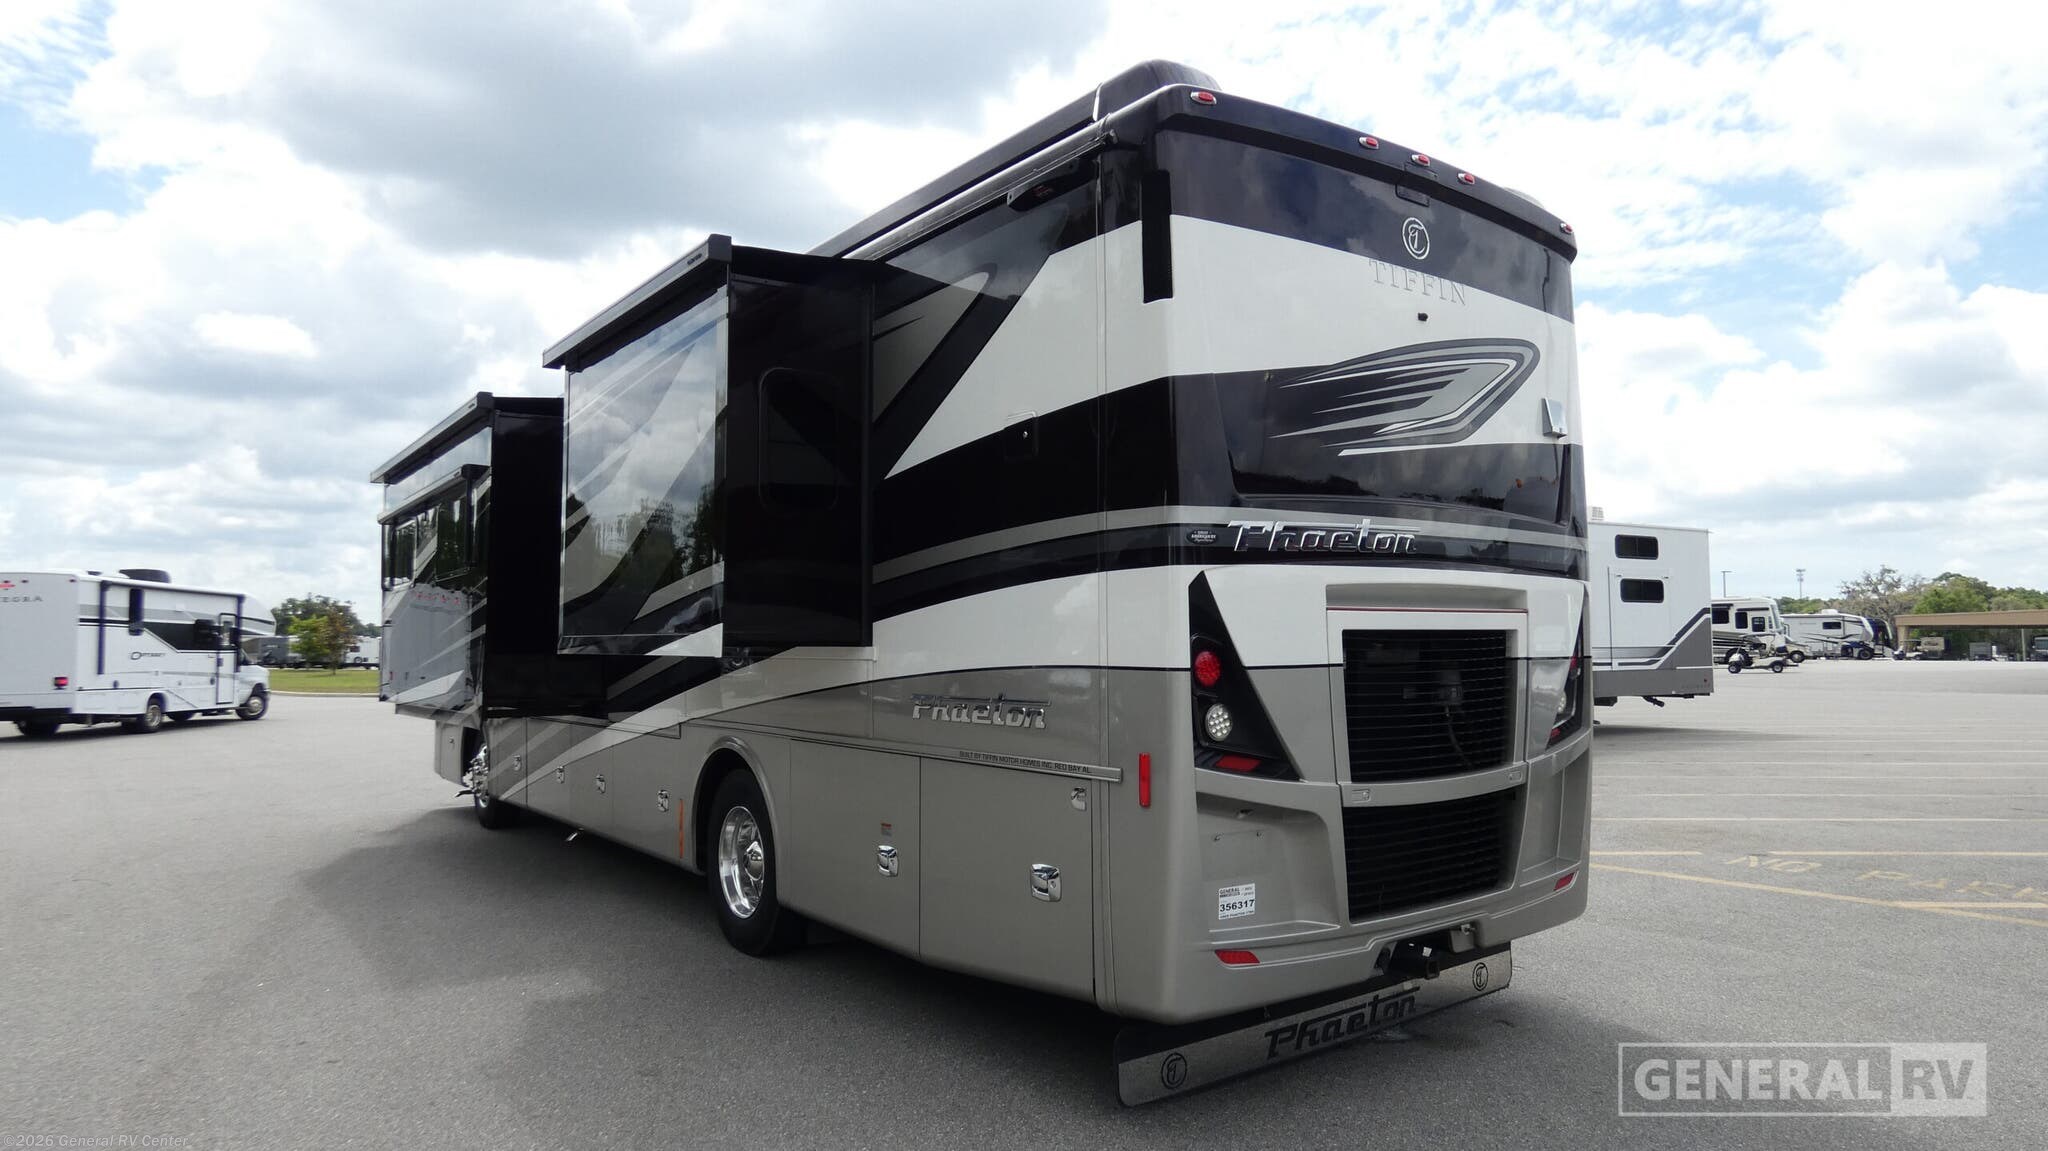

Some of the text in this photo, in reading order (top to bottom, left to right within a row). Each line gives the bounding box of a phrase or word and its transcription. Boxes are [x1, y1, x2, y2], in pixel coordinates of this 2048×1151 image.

[1368, 258, 1466, 306] TIFFIN
[1227, 518, 1421, 553] Phaeton
[911, 693, 1050, 729] Phaeton
[999, 756, 1020, 765] MOTOR
[1020, 758, 1041, 767] HOMES
[1054, 762, 1067, 771] RED
[1068, 764, 1081, 773] BAY
[1219, 899, 1254, 912] 356317
[1264, 985, 1420, 1060] Phaeton
